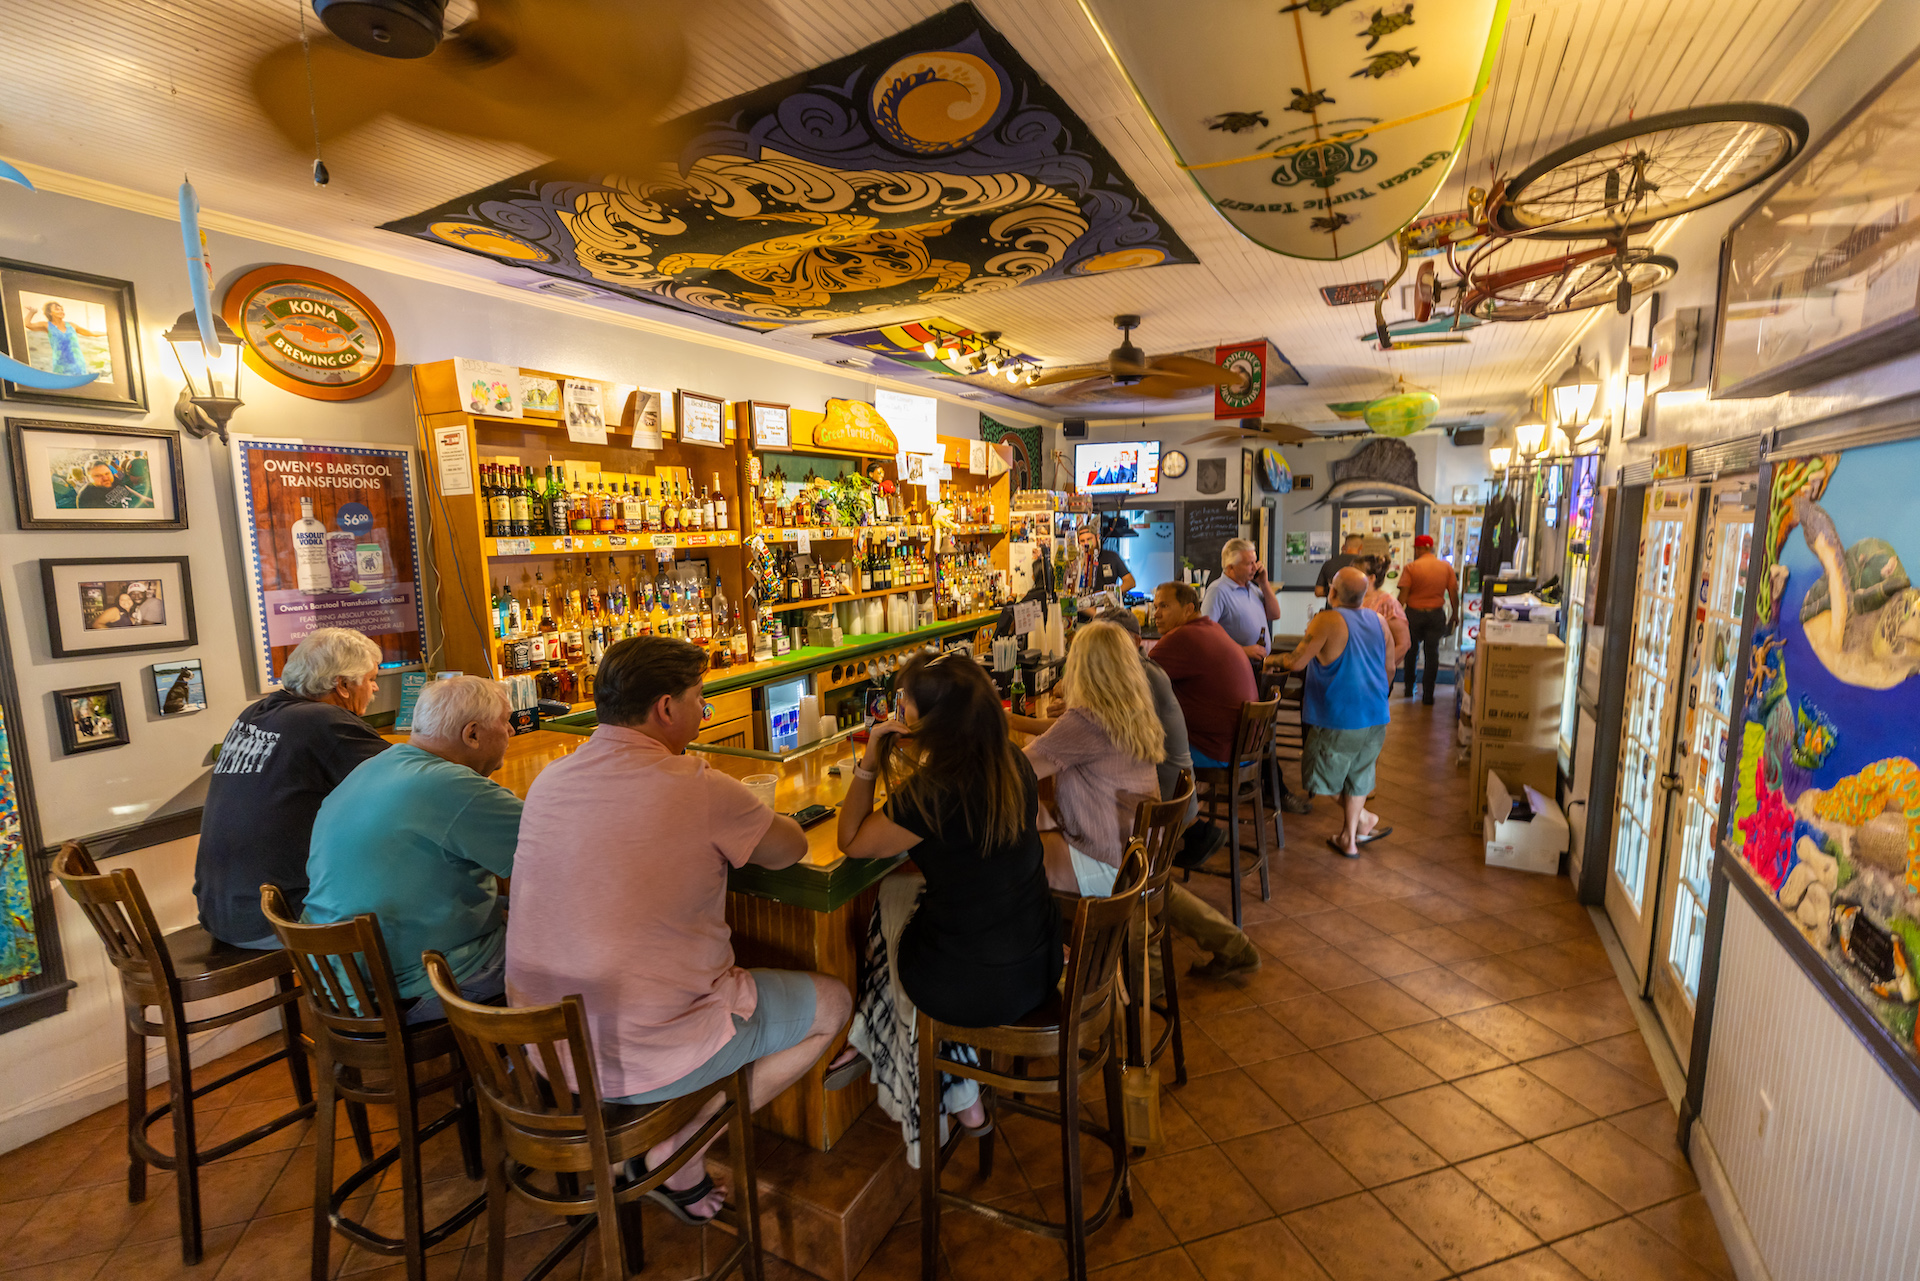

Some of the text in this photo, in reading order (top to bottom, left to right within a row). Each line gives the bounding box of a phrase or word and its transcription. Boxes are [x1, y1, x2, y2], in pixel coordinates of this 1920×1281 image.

[1217, 150, 1452, 214] Green Turtle Tavern
[288, 300, 338, 322] KONA
[274, 337, 358, 367] BREWING CO.
[1222, 350, 1262, 374] OODCHUCK
[1221, 381, 1260, 408] DRAFT CIDER
[821, 424, 894, 450] Green Turtle Tavern
[263, 459, 392, 477] OWEN'S BARSTOOL
[280, 474, 381, 489] TRANSFUSIONS
[296, 532, 325, 540] ABSOLUT
[299, 538, 324, 546] VODKA
[279, 595, 405, 613] Owen's Barstool Transfusion Cocktail
[300, 613, 336, 623] FEATURING
[337, 611, 365, 619] ABSOLUT
[367, 609, 389, 617] VODKA
[305, 621, 334, 630] OWEN'S
[335, 618, 379, 627] TRANSFUSION
[368, 622, 391, 630] GINGER
[547, 638, 559, 659] 7
